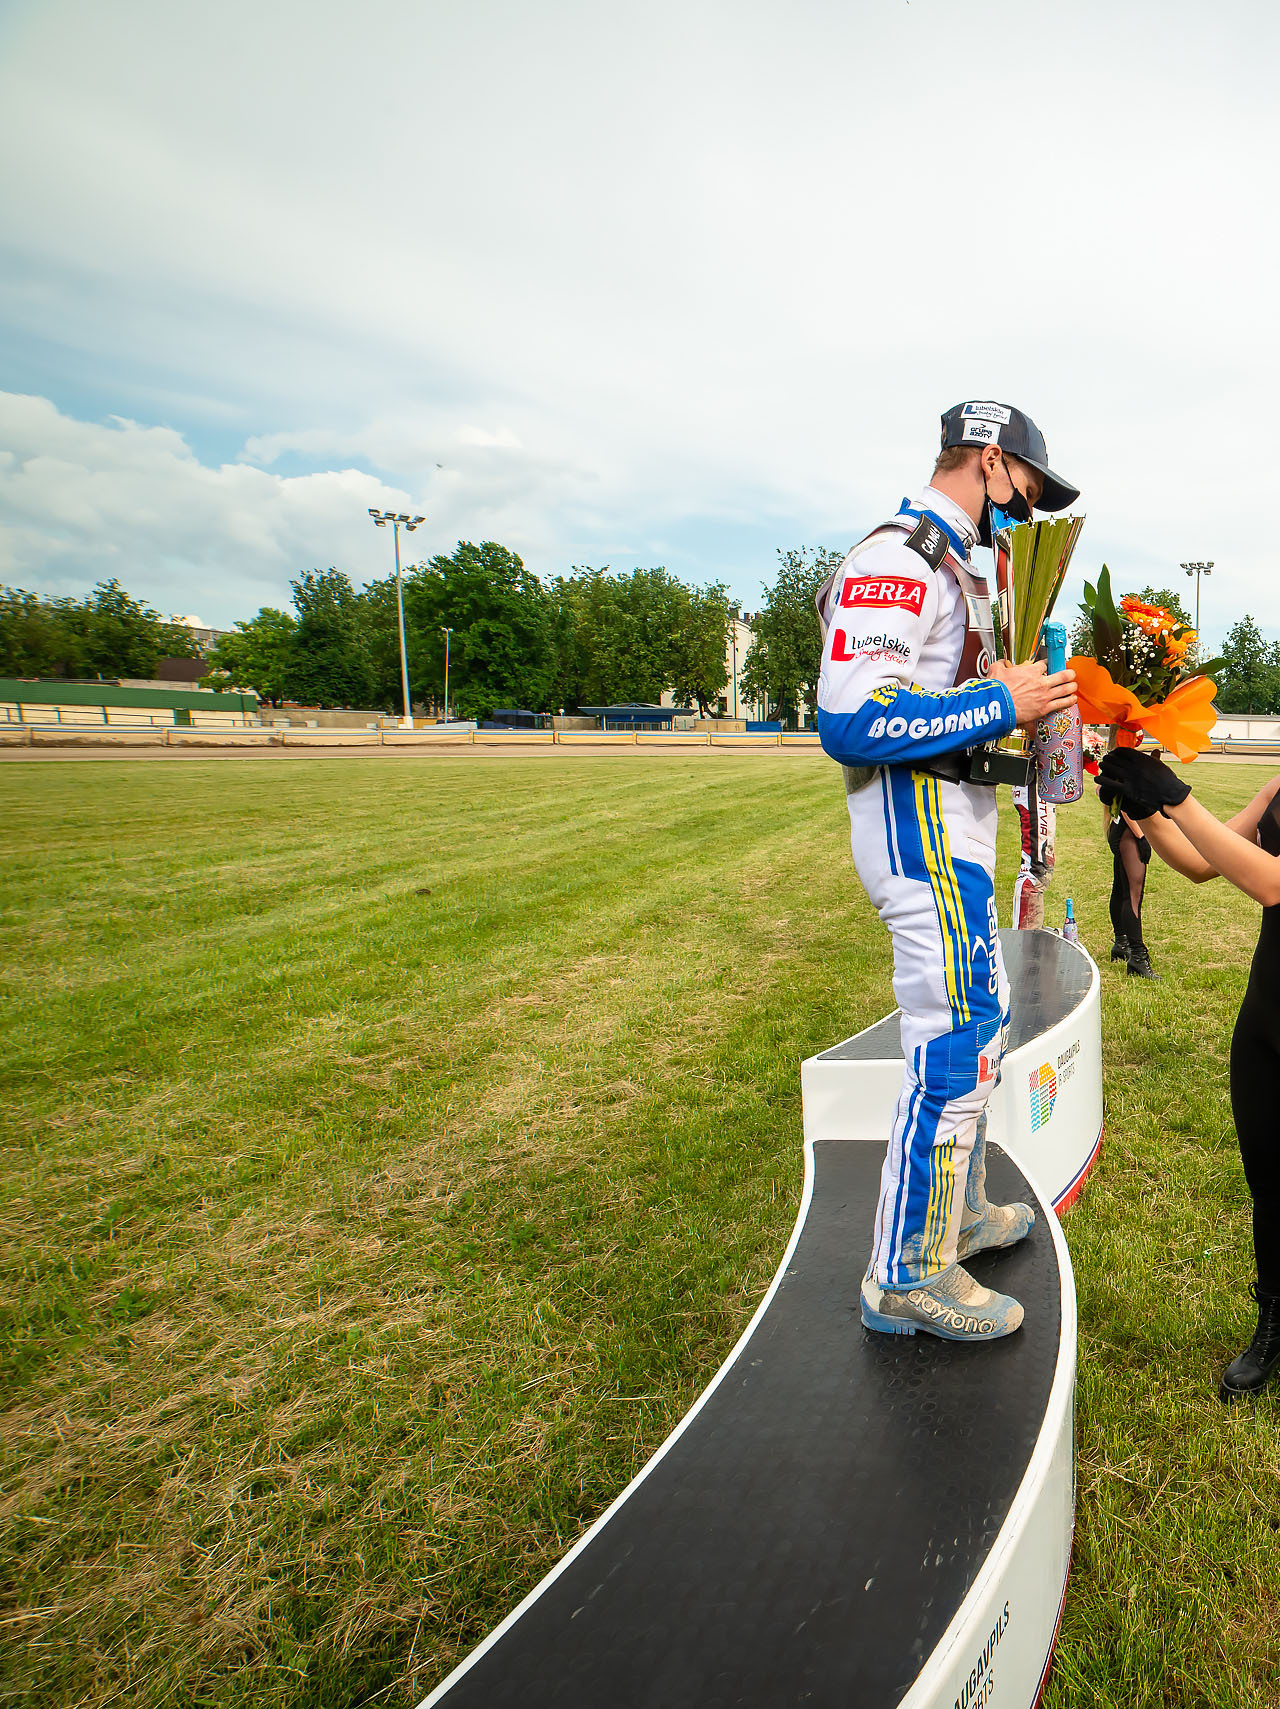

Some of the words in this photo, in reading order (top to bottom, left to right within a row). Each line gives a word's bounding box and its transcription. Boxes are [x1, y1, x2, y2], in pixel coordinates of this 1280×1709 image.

[848, 582, 921, 605] PERŁA
[851, 633, 911, 657] lubelskie
[867, 700, 1002, 740] BOGDANKA
[906, 1289, 998, 1334] daytona
